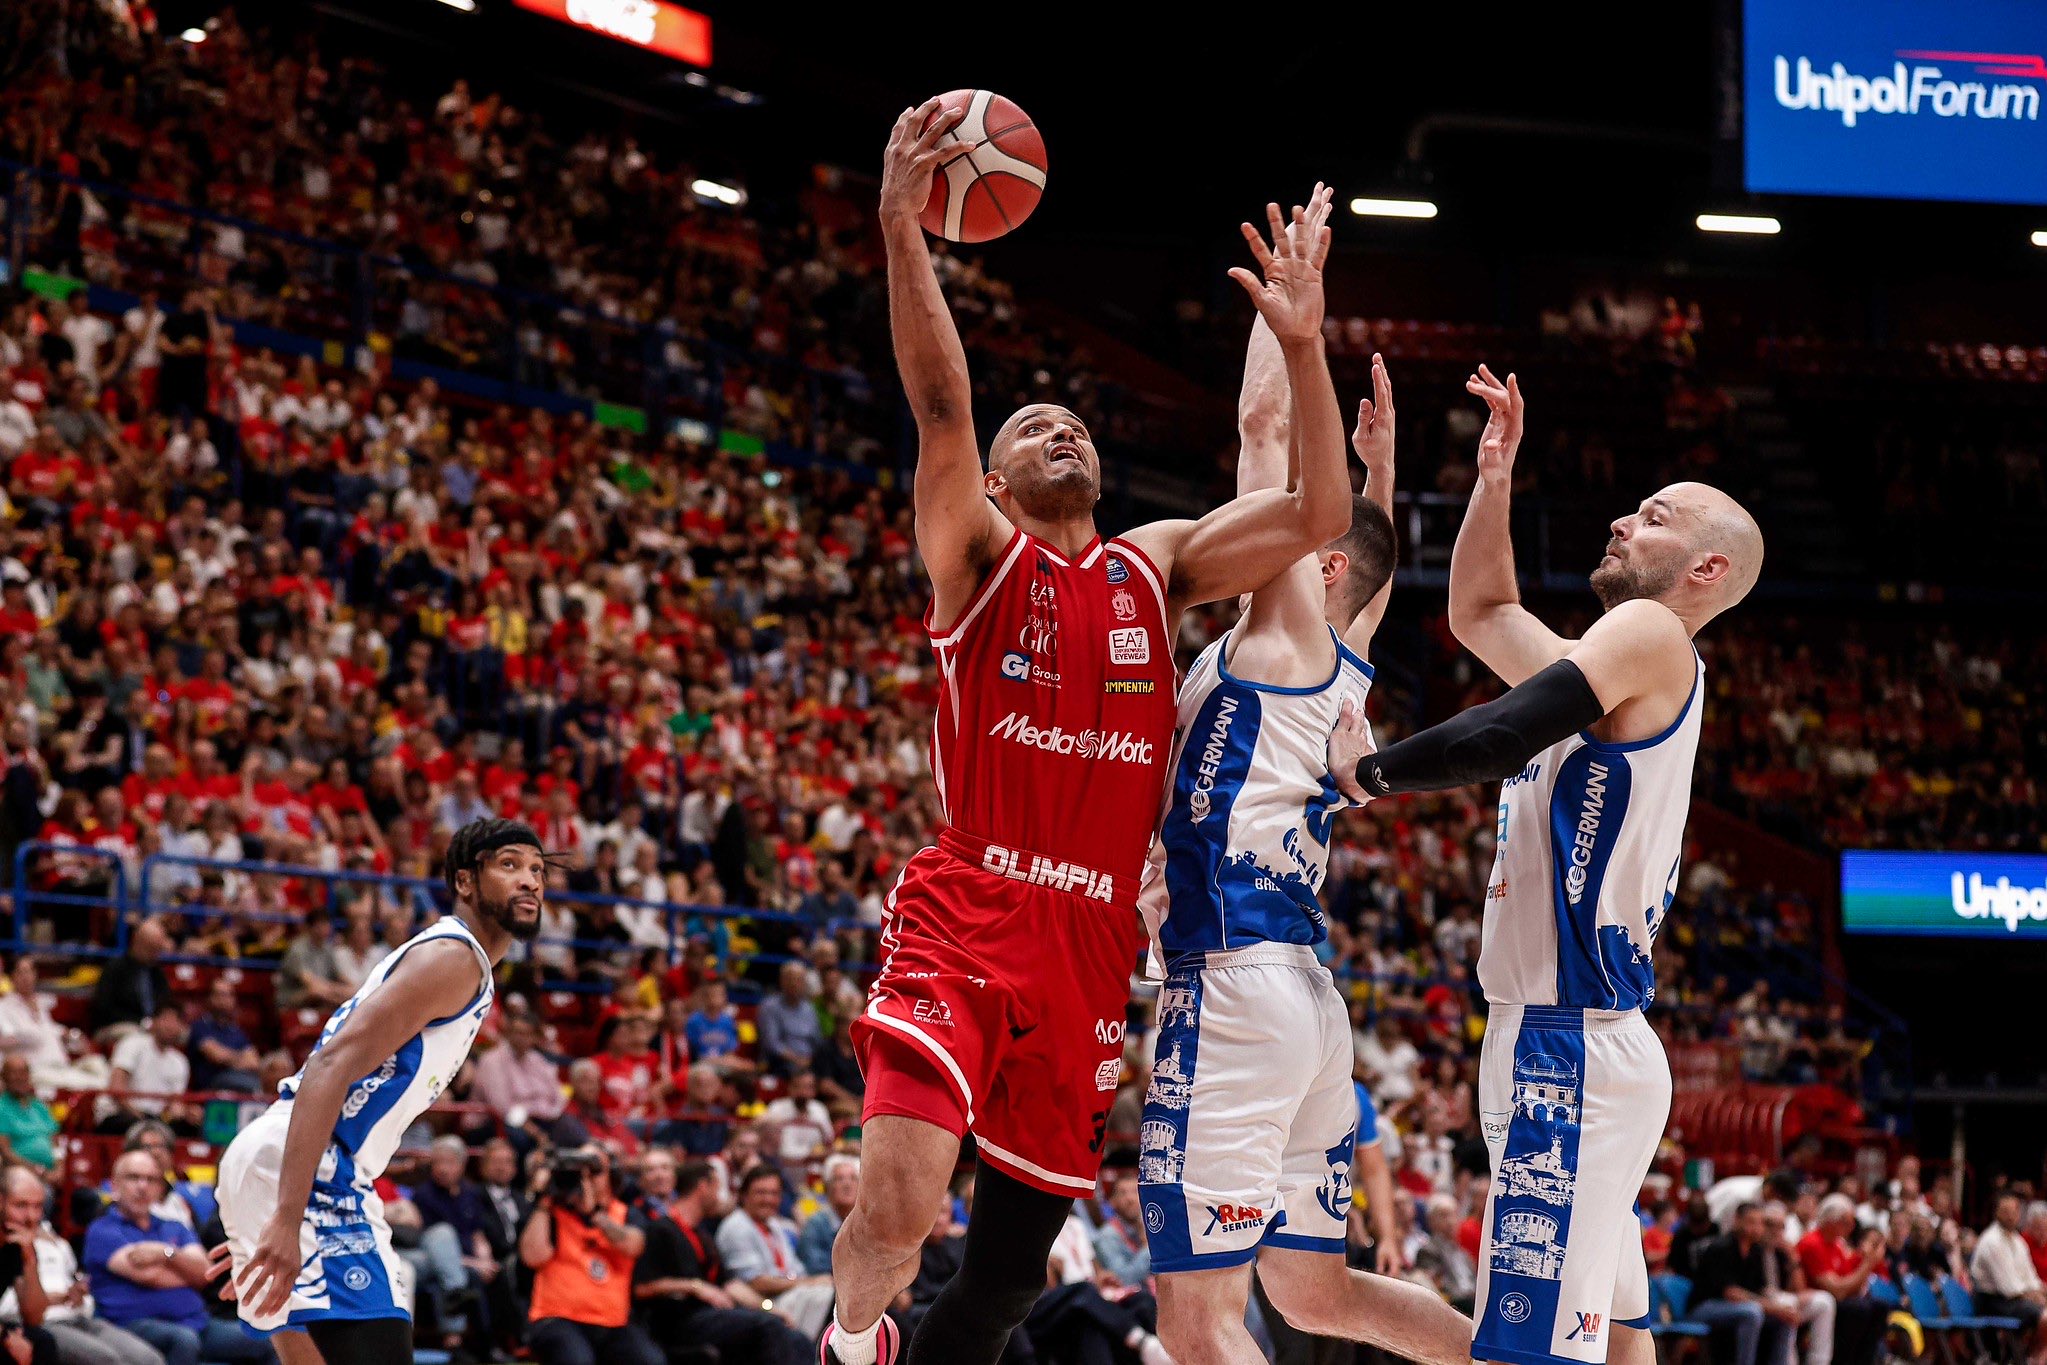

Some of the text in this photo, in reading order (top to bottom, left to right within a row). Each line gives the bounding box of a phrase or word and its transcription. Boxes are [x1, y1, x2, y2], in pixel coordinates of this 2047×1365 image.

[1774, 54, 2040, 128] UnipolForum
[1111, 592, 1136, 616] 90
[1112, 630, 1144, 649] EA7
[1114, 652, 1147, 660] EYEWEAR
[1001, 654, 1030, 680] Gi
[989, 711, 1076, 756] Media
[1195, 696, 1240, 793] GERMANI
[1571, 761, 1610, 868] GERMANI
[981, 844, 1114, 904] OLIMPIA
[1951, 870, 2047, 933] Unipo
[912, 999, 952, 1020] EA7
[1221, 1217, 1265, 1233] SERVICE
